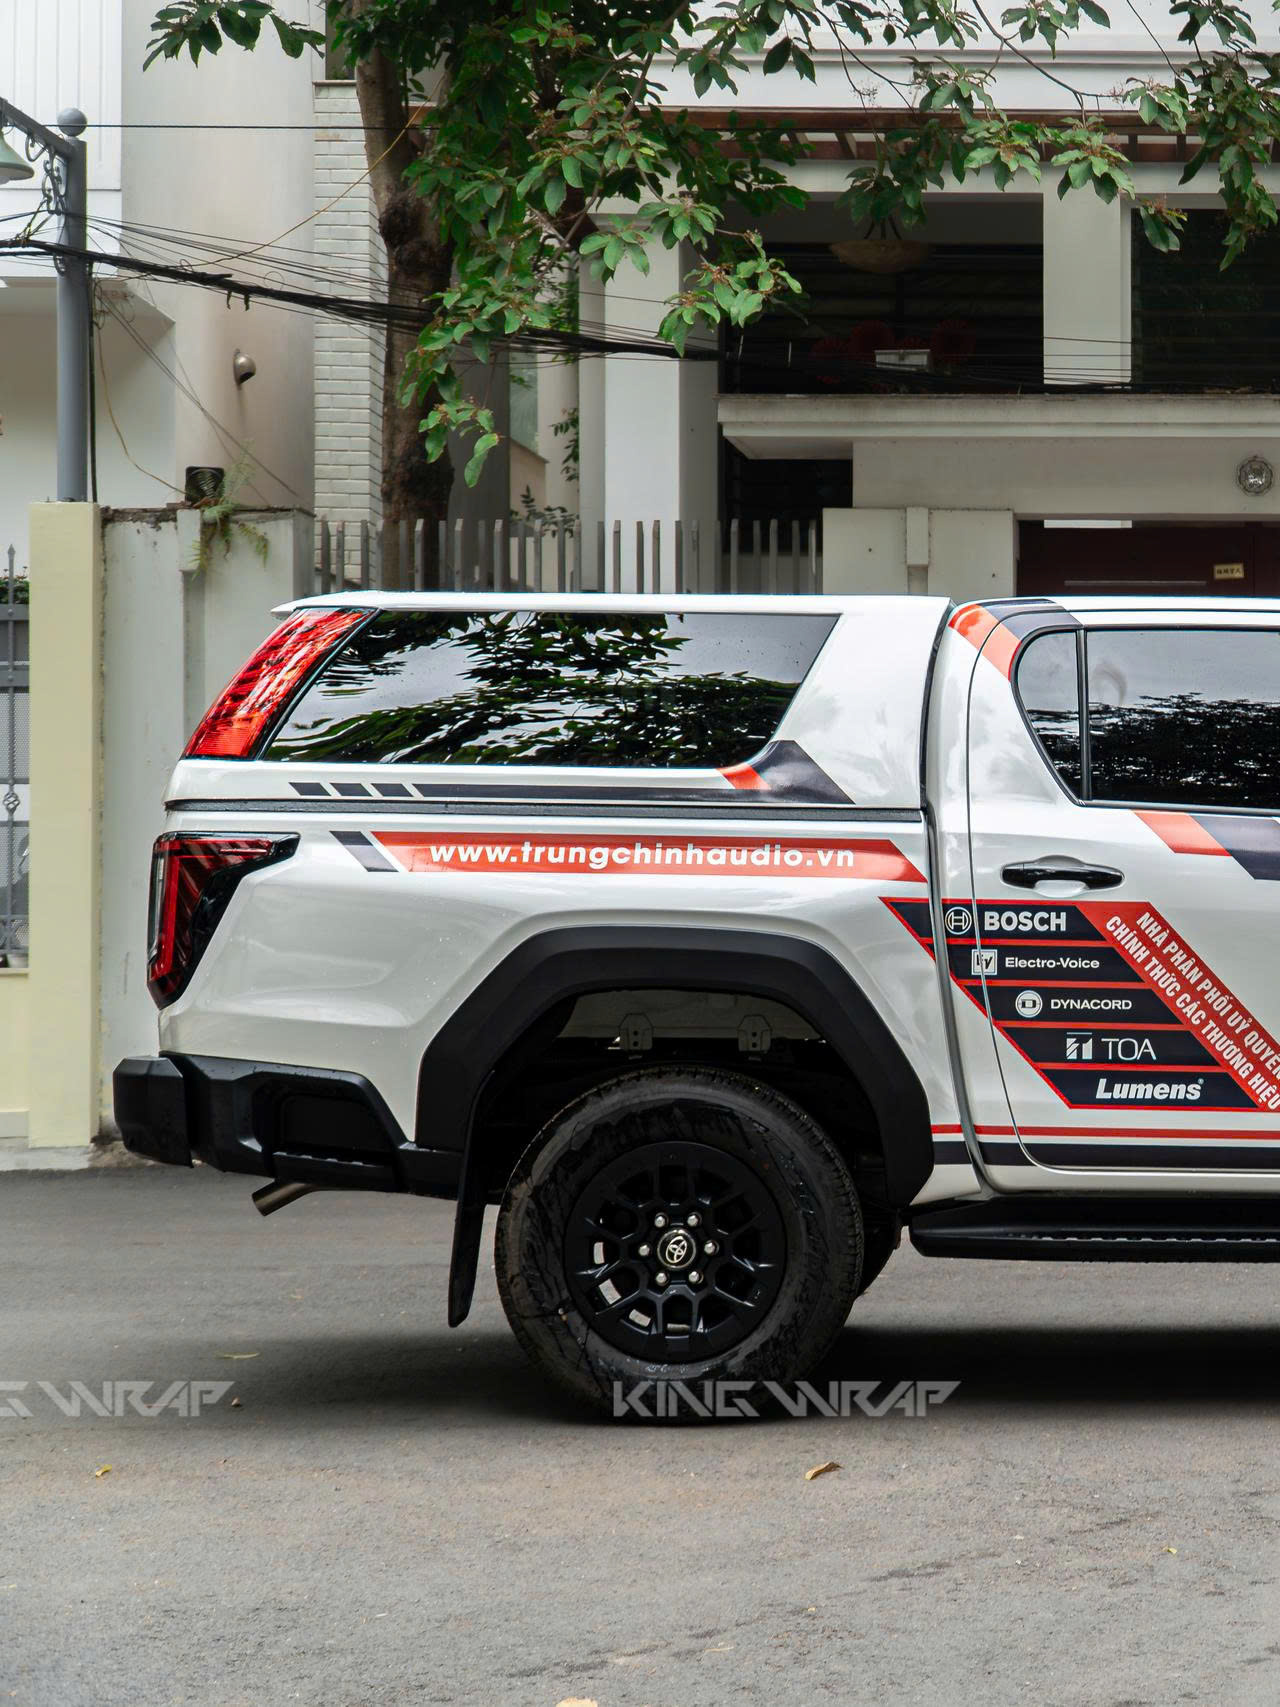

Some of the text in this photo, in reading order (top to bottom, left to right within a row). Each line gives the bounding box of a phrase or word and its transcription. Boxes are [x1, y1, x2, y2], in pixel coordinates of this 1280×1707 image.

[429, 841, 855, 870] www.trungchinhaudio.vn
[984, 911, 1067, 932] BOSCH
[1005, 956, 1100, 970] Electro-Voice
[1136, 912, 1170, 947] NHÀ
[1162, 941, 1204, 984] PHÂN
[1196, 978, 1234, 1017] PHỐI
[1050, 999, 1133, 1011] DYNACORD
[1106, 916, 1150, 963] CHÍNH
[1144, 956, 1181, 997] THỨC
[1175, 993, 1206, 1025] CÁC
[1201, 1019, 1254, 1079] THƯƠNG
[1101, 1038, 1157, 1061] TOA
